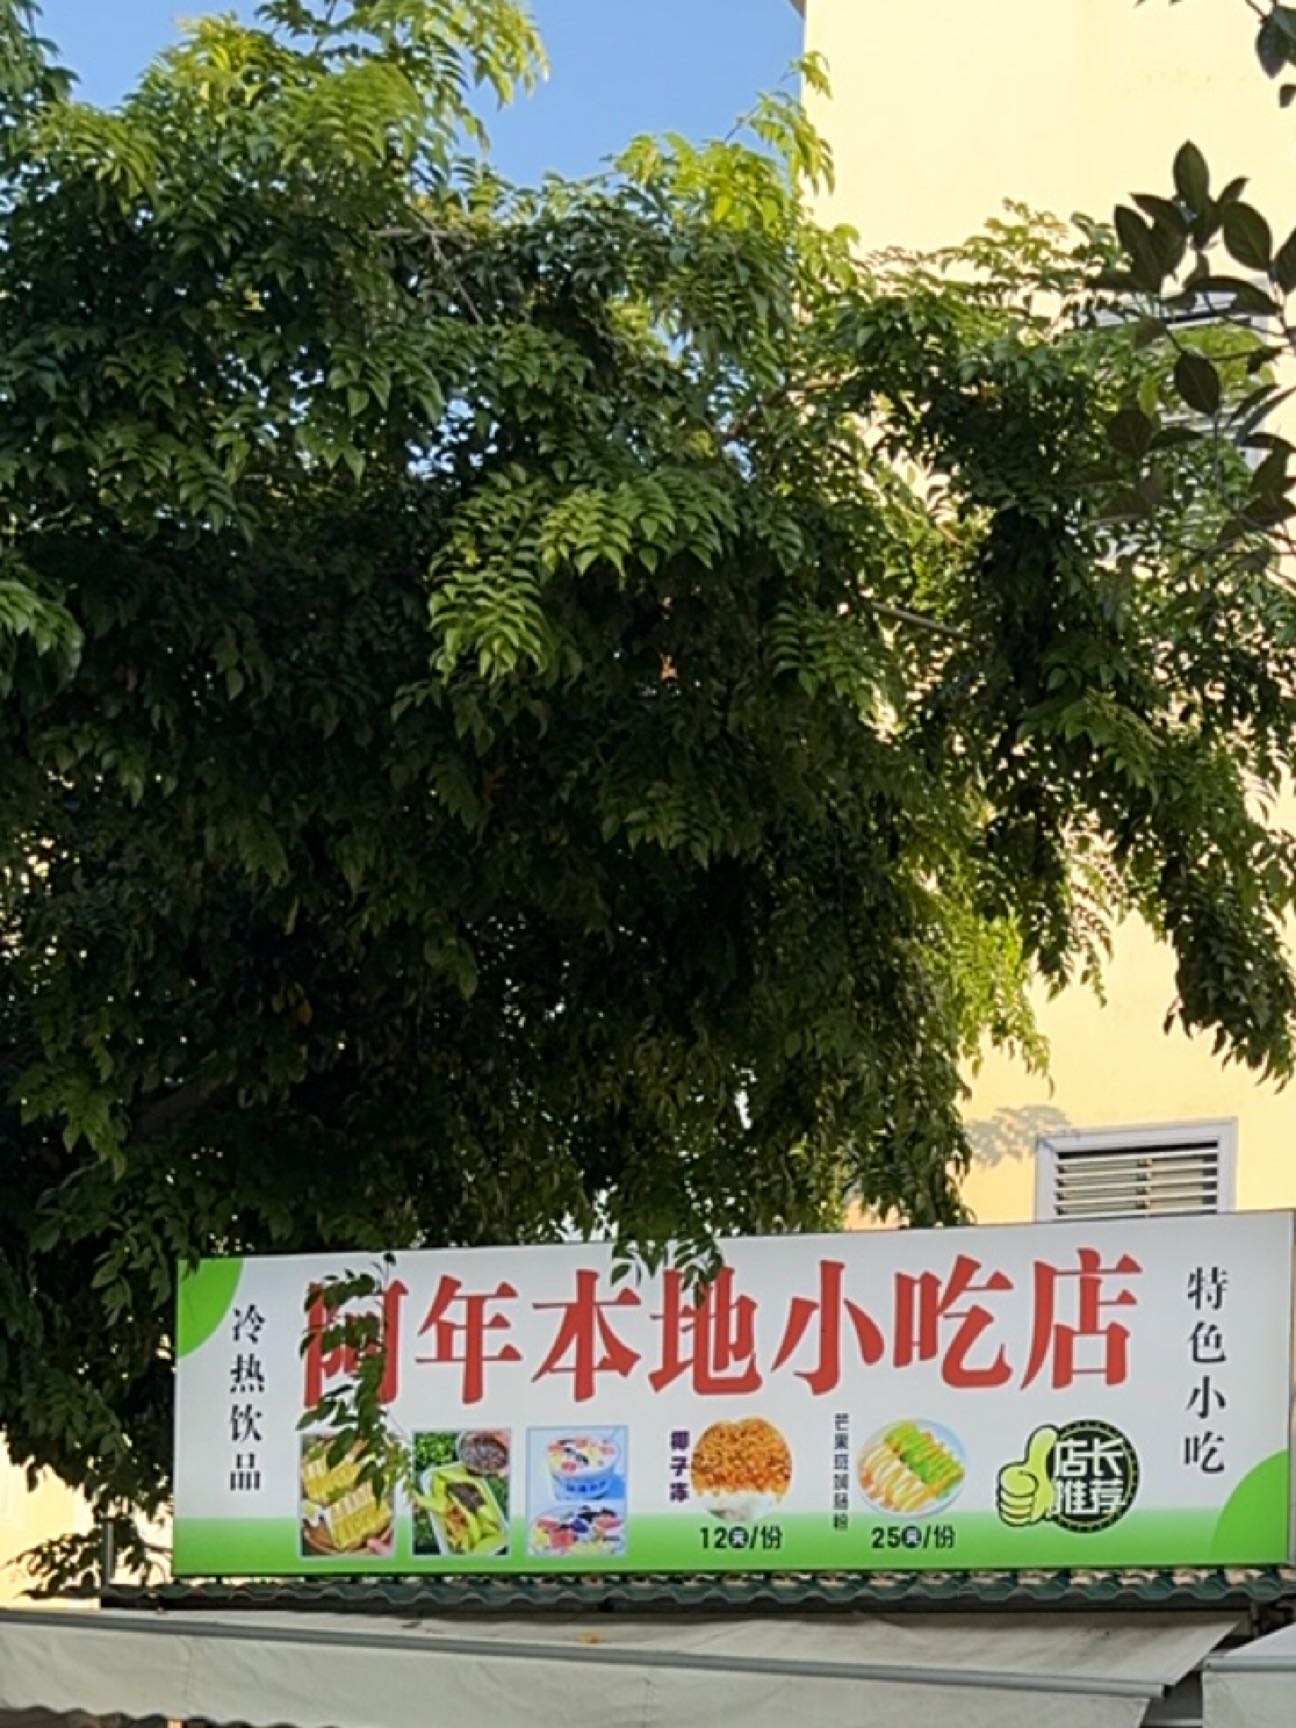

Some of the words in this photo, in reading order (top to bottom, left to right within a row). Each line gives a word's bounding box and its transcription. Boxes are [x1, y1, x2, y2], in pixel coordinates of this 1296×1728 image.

[230, 1304, 266, 1492] 冷热饮品
[302, 1248, 1142, 1407] 阿年本地小吃店
[1184, 1266, 1228, 1474] 特色小吃
[1050, 1478, 1125, 1517] 推荐
[1053, 1437, 1124, 1479] 店长
